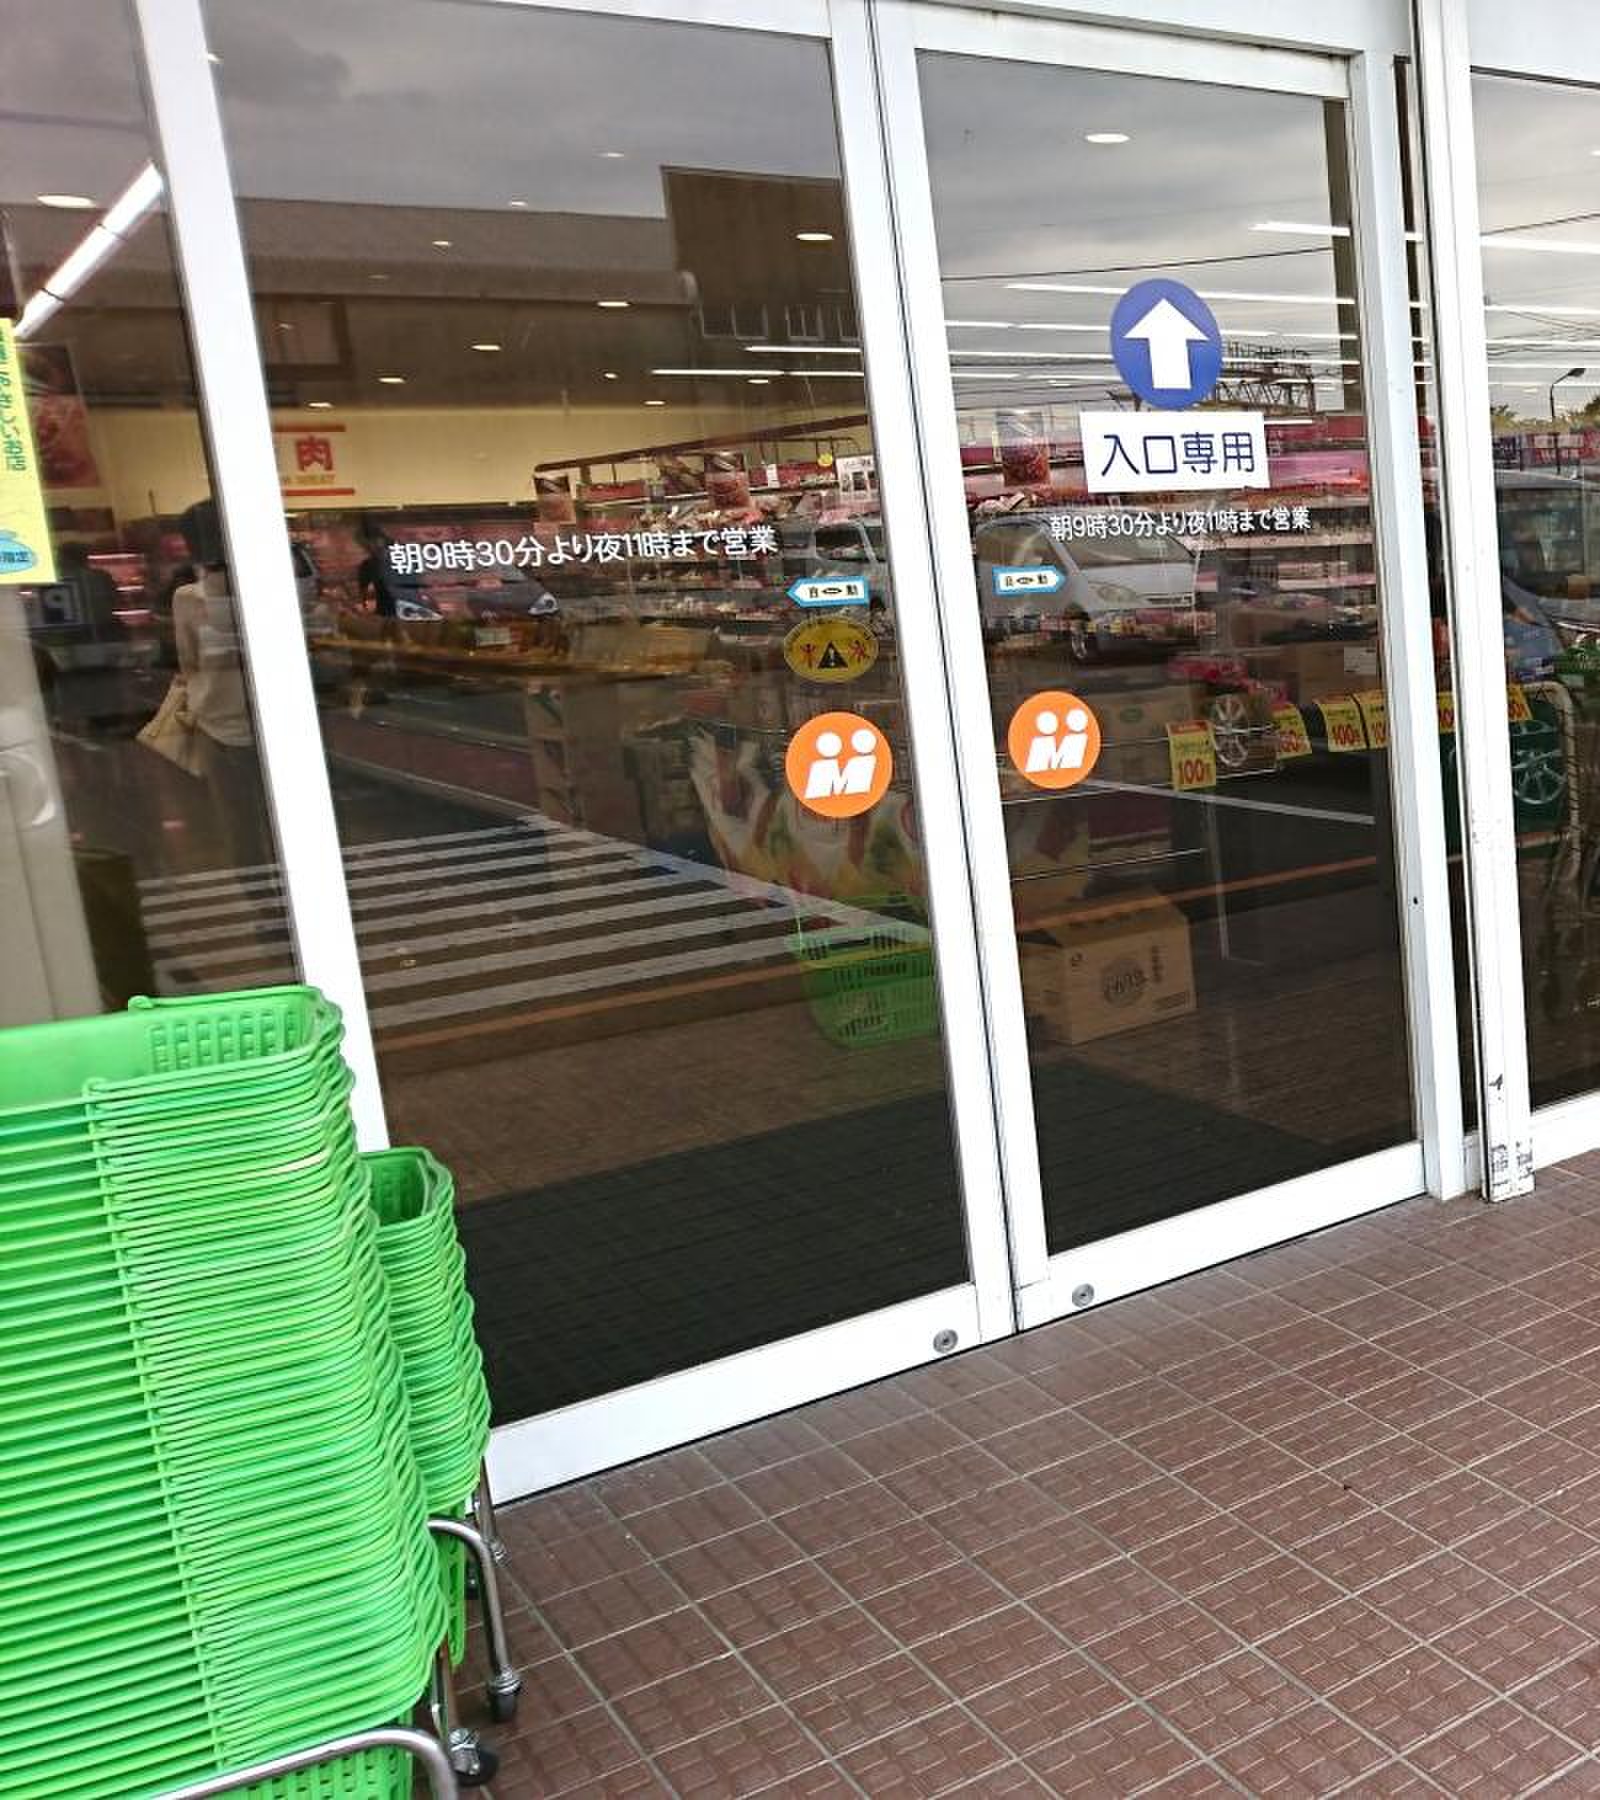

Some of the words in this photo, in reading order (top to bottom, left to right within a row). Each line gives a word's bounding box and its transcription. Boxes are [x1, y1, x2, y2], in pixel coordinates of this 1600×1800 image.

[295, 436, 332, 471] 肉
[1101, 432, 1256, 477] 入口専用
[1050, 506, 1311, 541] 朝9時30分より夜11時まで営業
[389, 526, 778, 575] 朝9時30分より夜11時まで営業
